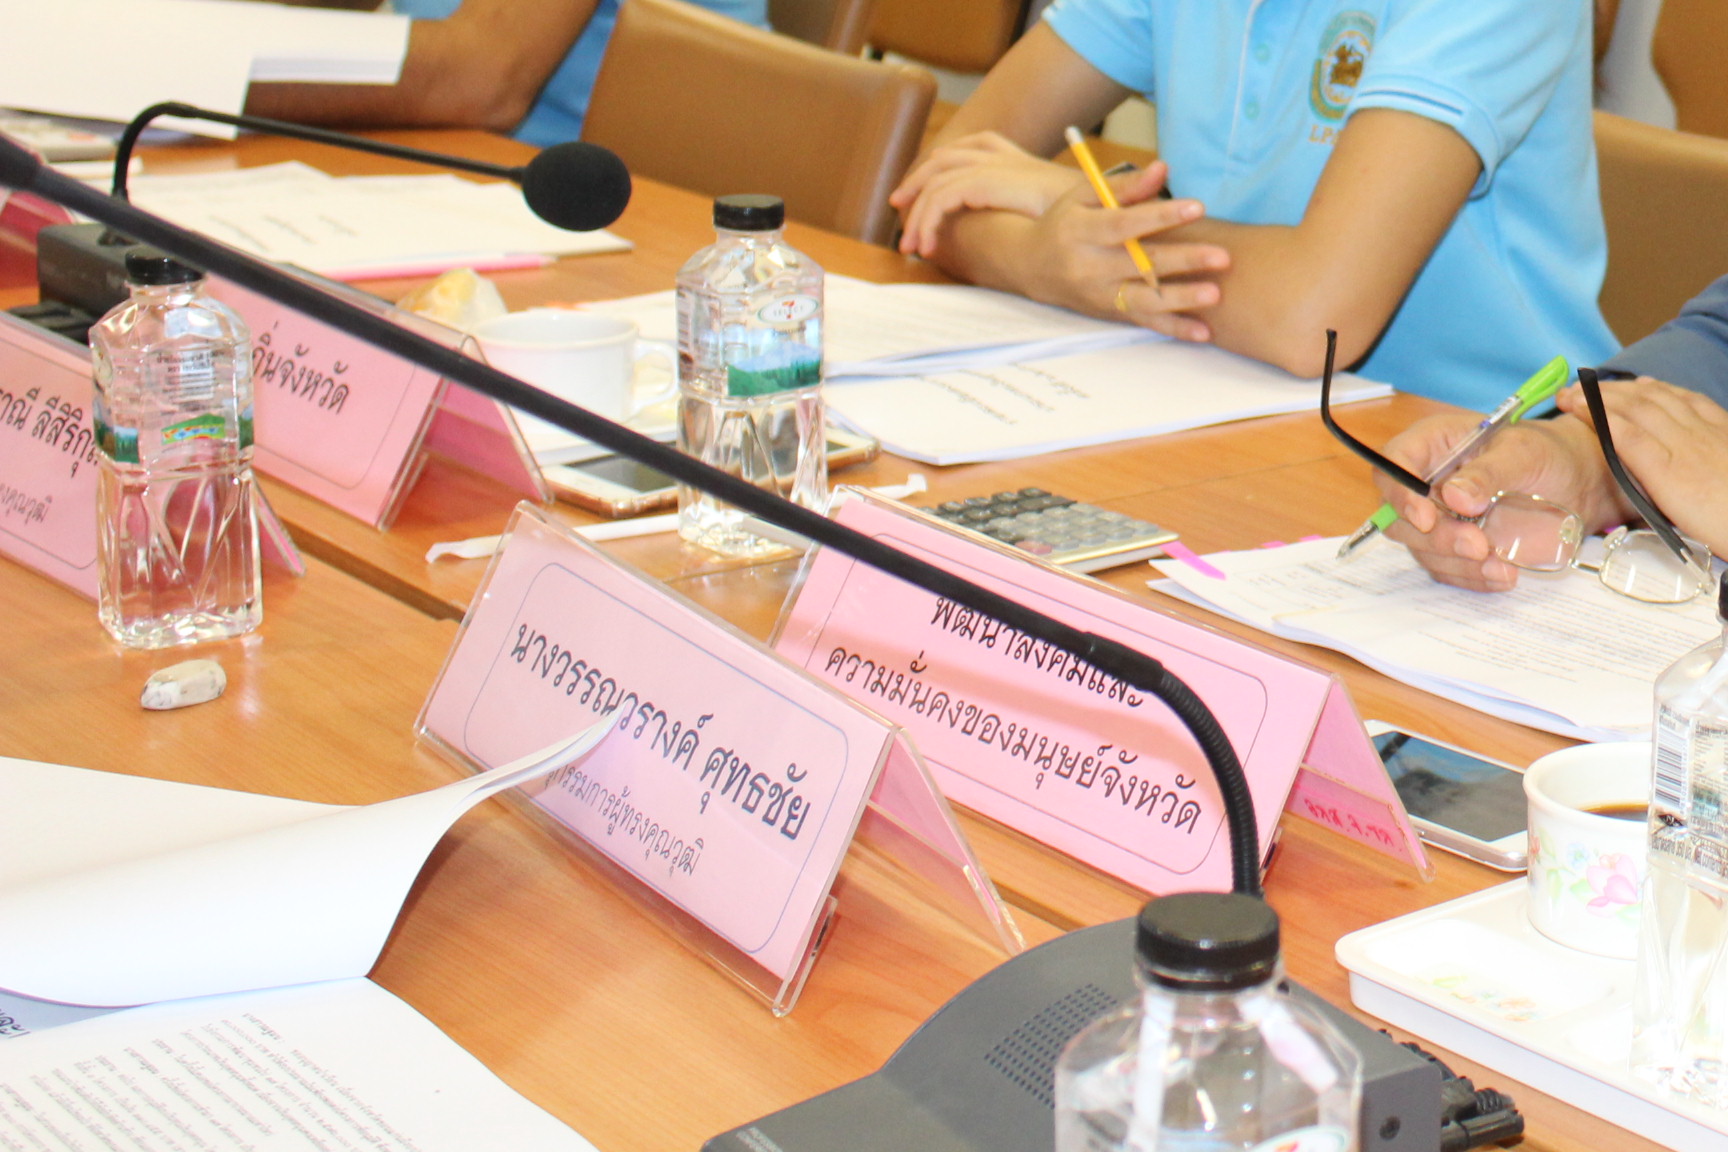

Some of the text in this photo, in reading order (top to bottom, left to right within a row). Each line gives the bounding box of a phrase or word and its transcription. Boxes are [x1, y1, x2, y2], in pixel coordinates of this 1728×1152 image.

[0, 387, 41, 430] าณี
[825, 645, 1202, 835] ความมั่นคงของมนุษย์จังหวัด
[699, 741, 811, 842] ศุทธชัย
